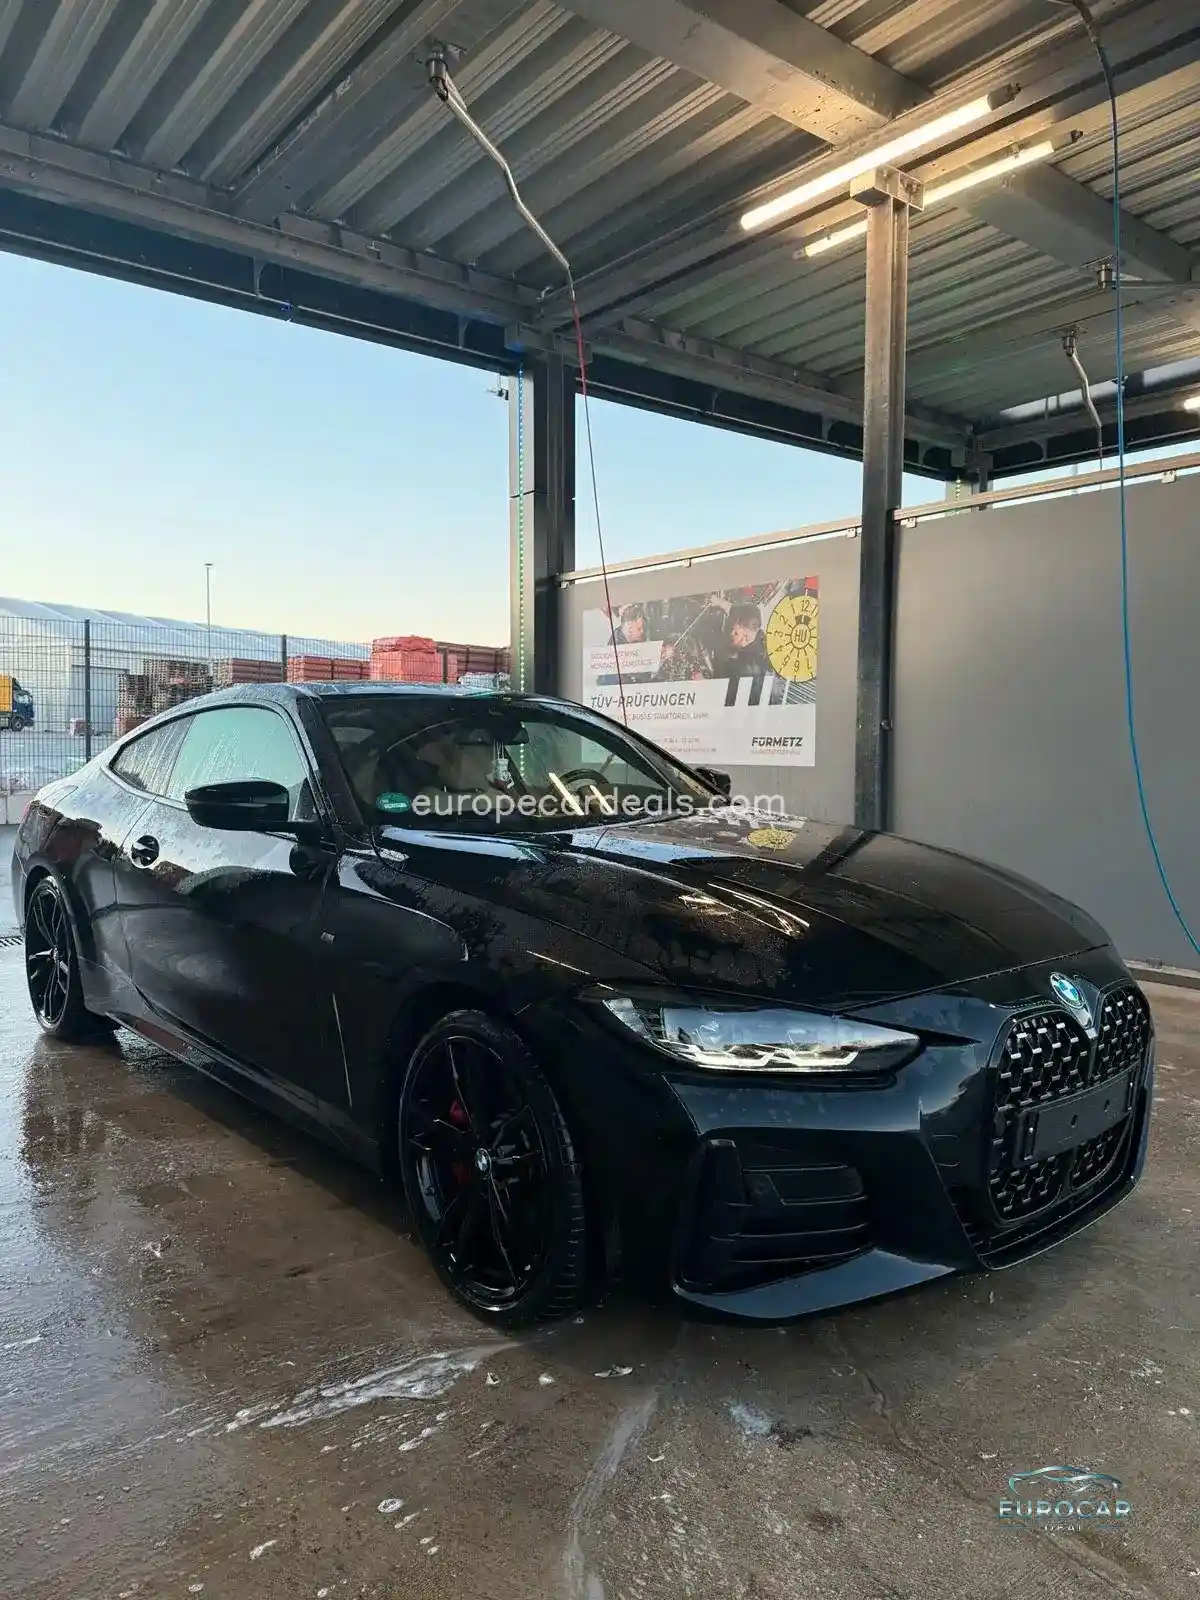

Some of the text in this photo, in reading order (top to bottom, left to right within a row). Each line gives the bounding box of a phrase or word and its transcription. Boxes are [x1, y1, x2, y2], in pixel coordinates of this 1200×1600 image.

[801, 600, 810, 612] 12
[794, 629, 807, 643] HU
[591, 692, 696, 708] TÜV-PRÜFUNGEN
